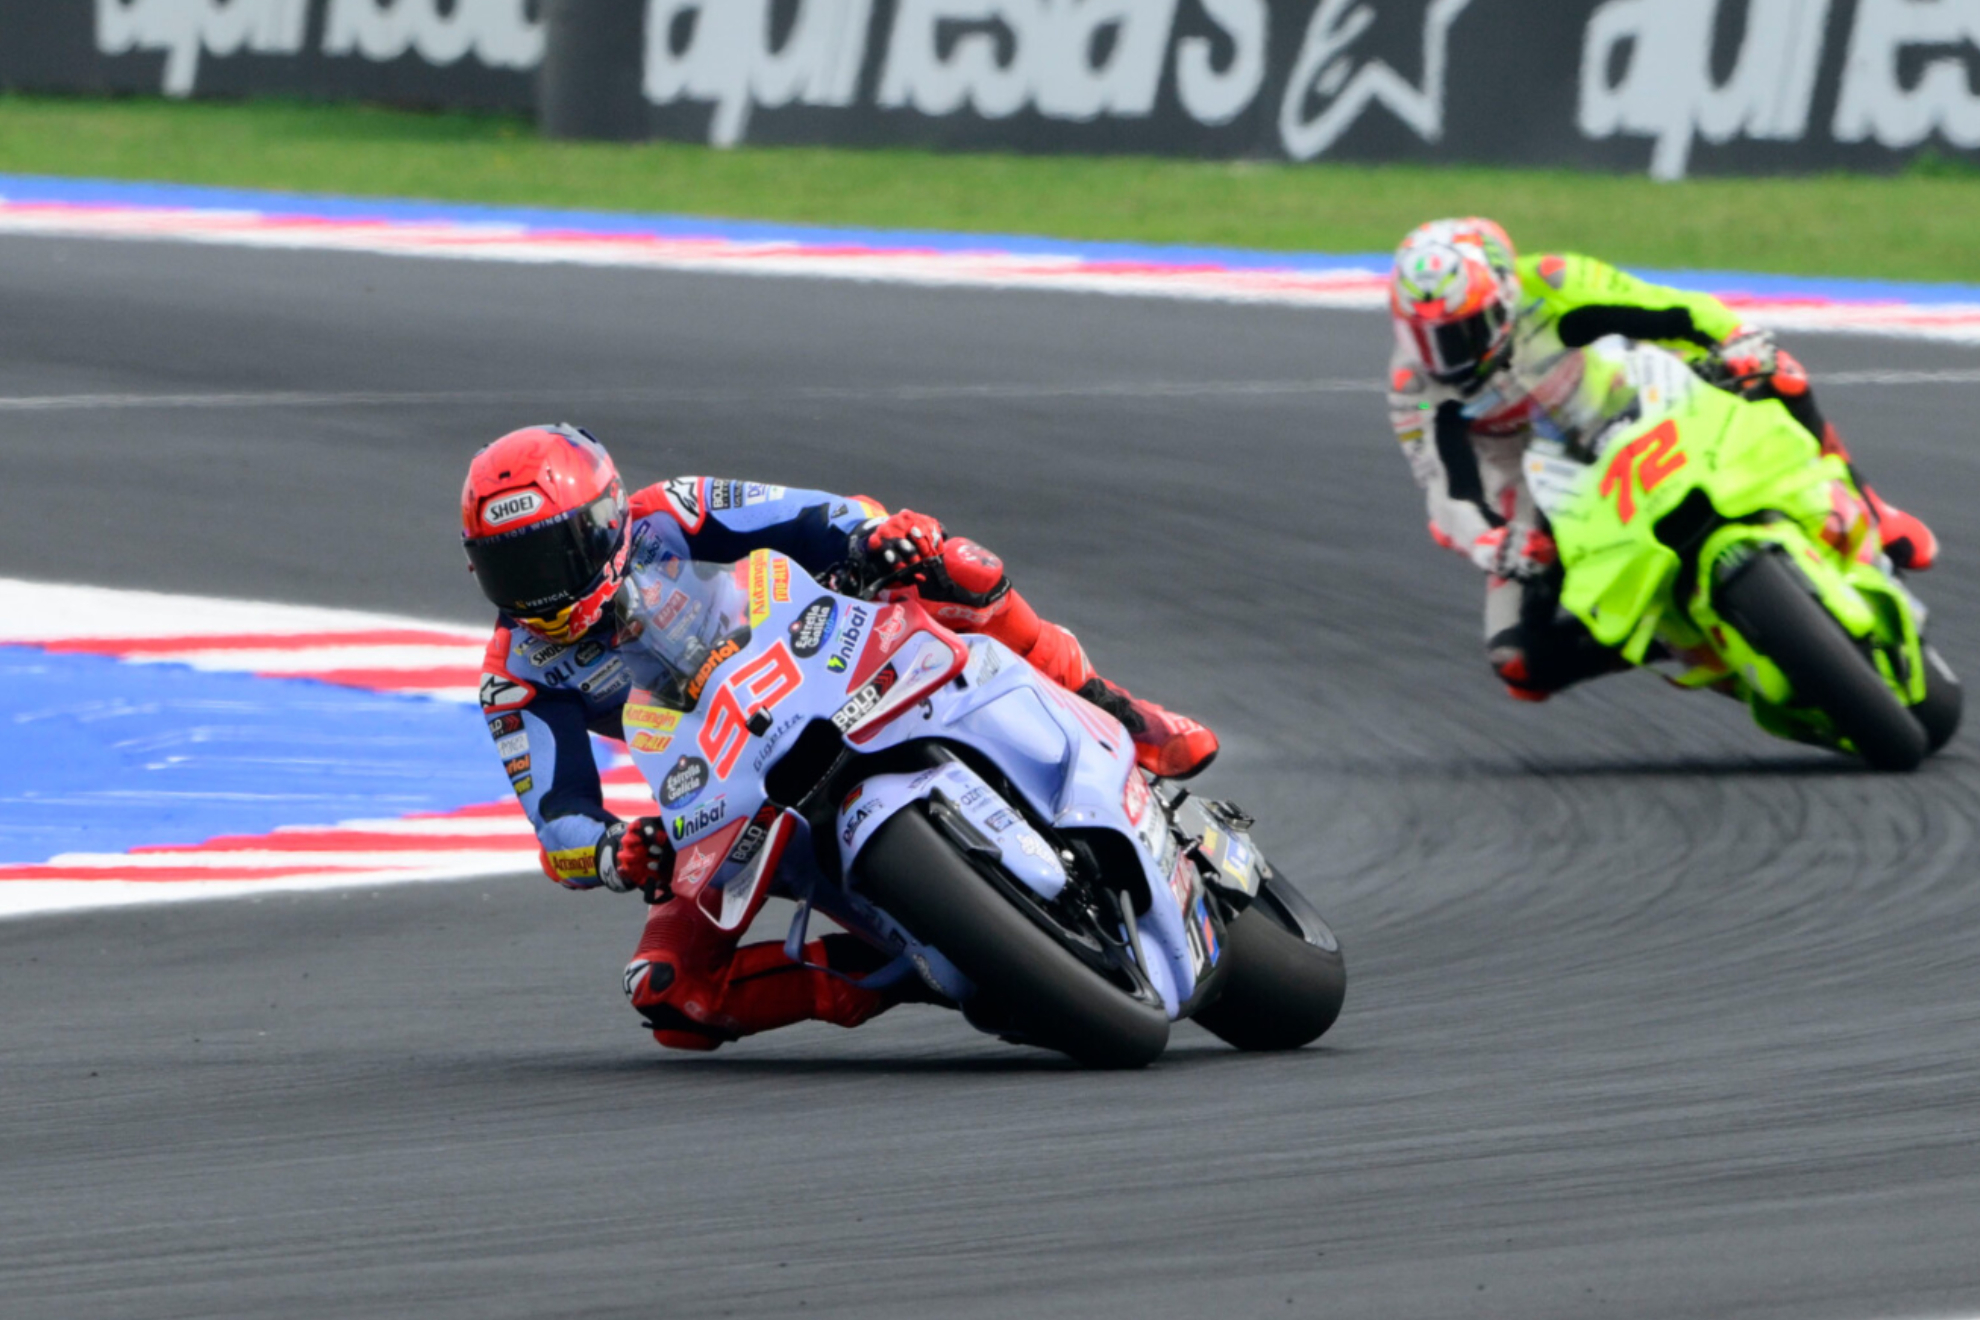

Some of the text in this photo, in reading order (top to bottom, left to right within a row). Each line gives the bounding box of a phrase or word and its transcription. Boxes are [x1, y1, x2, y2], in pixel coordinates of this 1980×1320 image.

[1598, 418, 1687, 524] 72
[490, 495, 534, 521] SHOEI
[531, 512, 570, 530] WINGS
[525, 590, 569, 607] VERTICAL
[795, 604, 821, 649] Estrella
[808, 606, 831, 648] Galicia
[827, 605, 868, 674] Unibat
[687, 639, 740, 700] Kapriol
[698, 638, 804, 781] 93
[832, 685, 878, 728] BOLD
[667, 763, 701, 790] Estrella
[667, 776, 701, 801] Galicia
[672, 799, 727, 841] Unibat
[732, 827, 763, 861] BOLD
